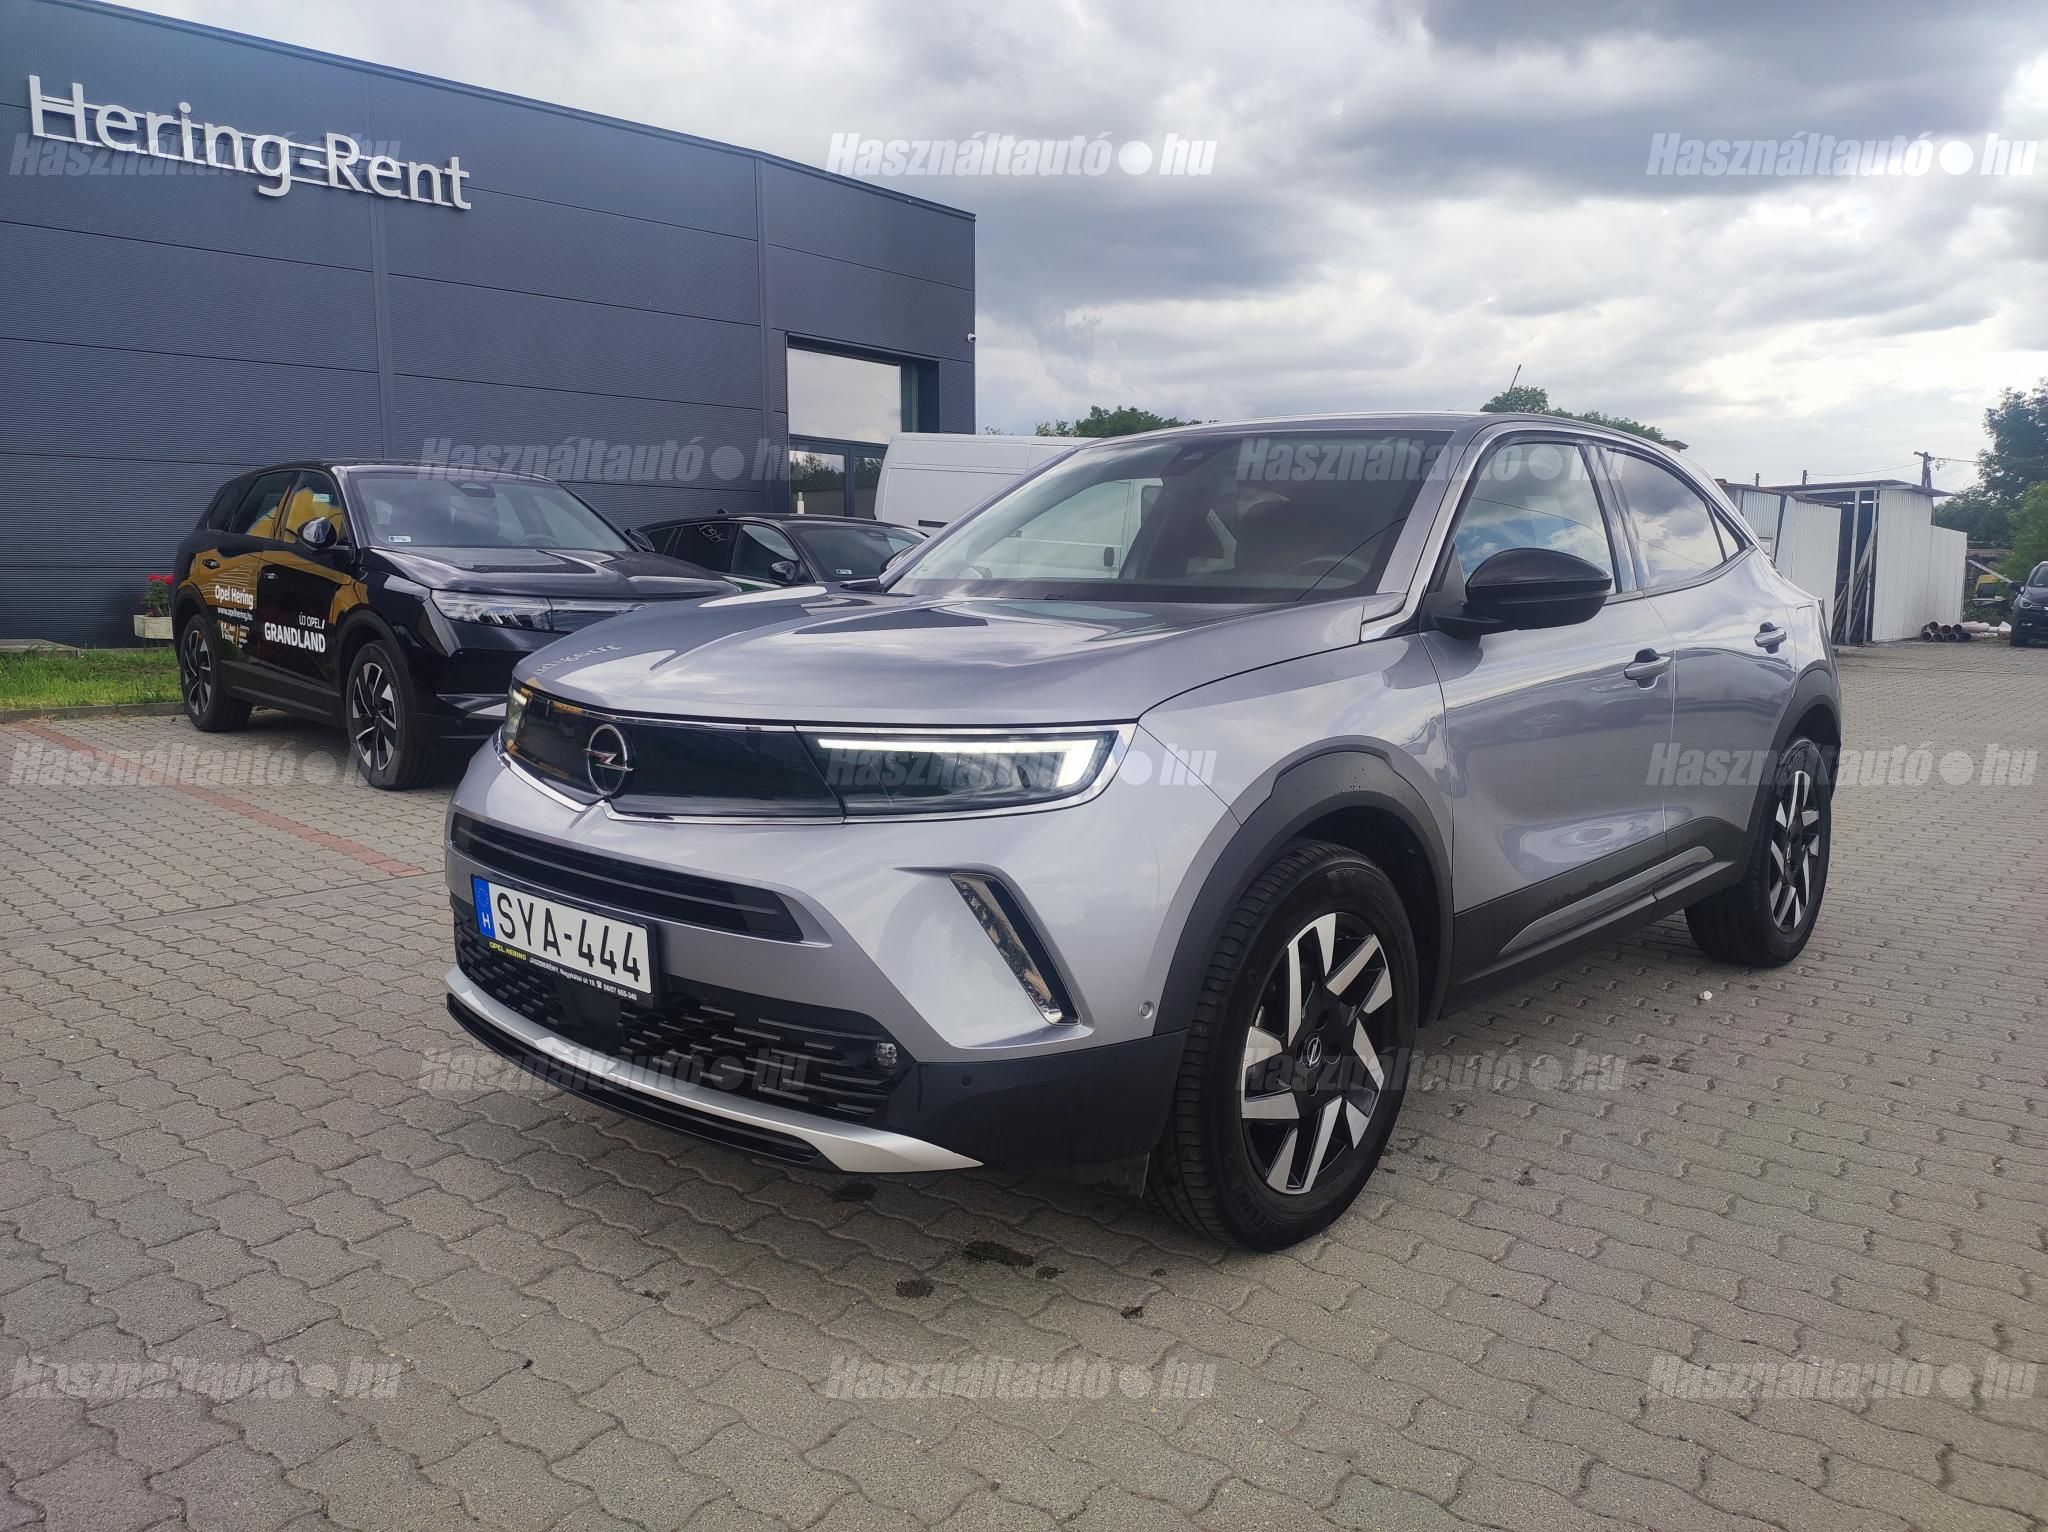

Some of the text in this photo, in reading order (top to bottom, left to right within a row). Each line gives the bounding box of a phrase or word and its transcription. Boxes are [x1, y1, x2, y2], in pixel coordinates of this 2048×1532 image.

[29, 75, 472, 210] Hering-Rent
[215, 585, 254, 610] Opel Hering
[264, 621, 326, 653] GRANDLAND
[482, 912, 491, 930] H
[497, 892, 641, 983] SYA-444
